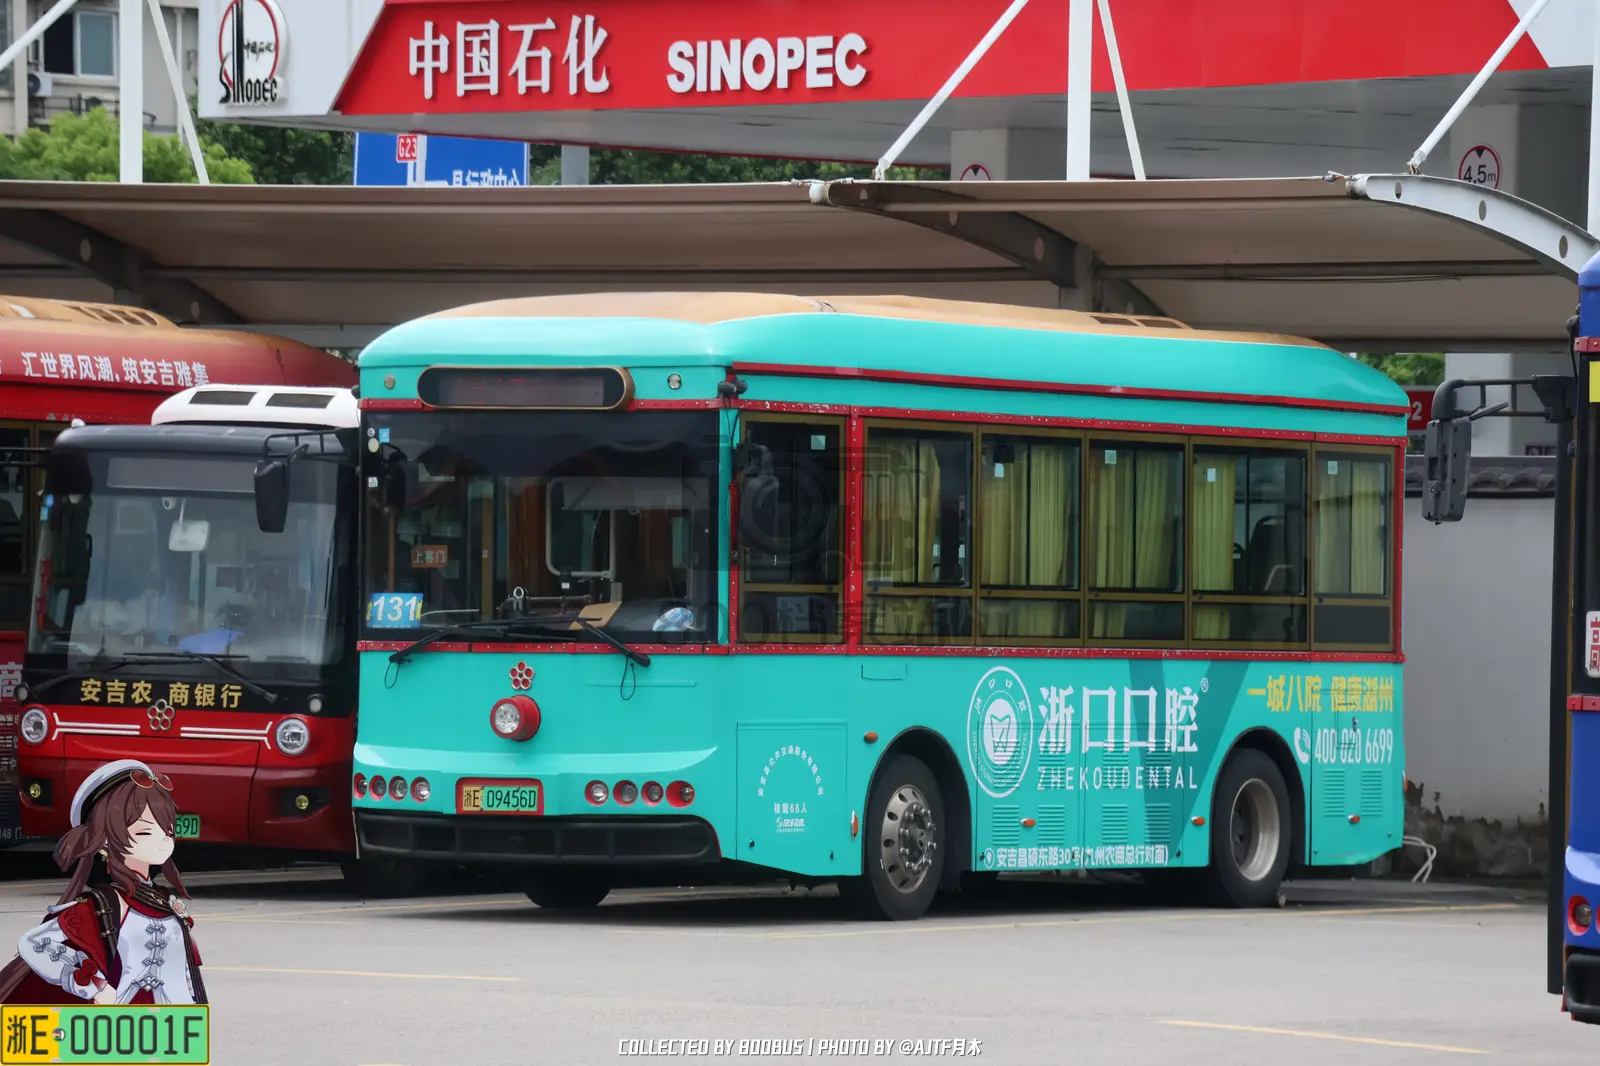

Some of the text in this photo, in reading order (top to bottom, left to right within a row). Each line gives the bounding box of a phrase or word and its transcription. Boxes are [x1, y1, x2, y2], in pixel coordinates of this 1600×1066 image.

[409, 14, 609, 100] 中国石化
[666, 33, 867, 93] SINOPEC
[1463, 165, 1496, 184] 4.5m
[373, 596, 417, 621] 131
[1248, 674, 1394, 713] 一城八院 健康湖州
[1314, 728, 1394, 764] 400 020 6699
